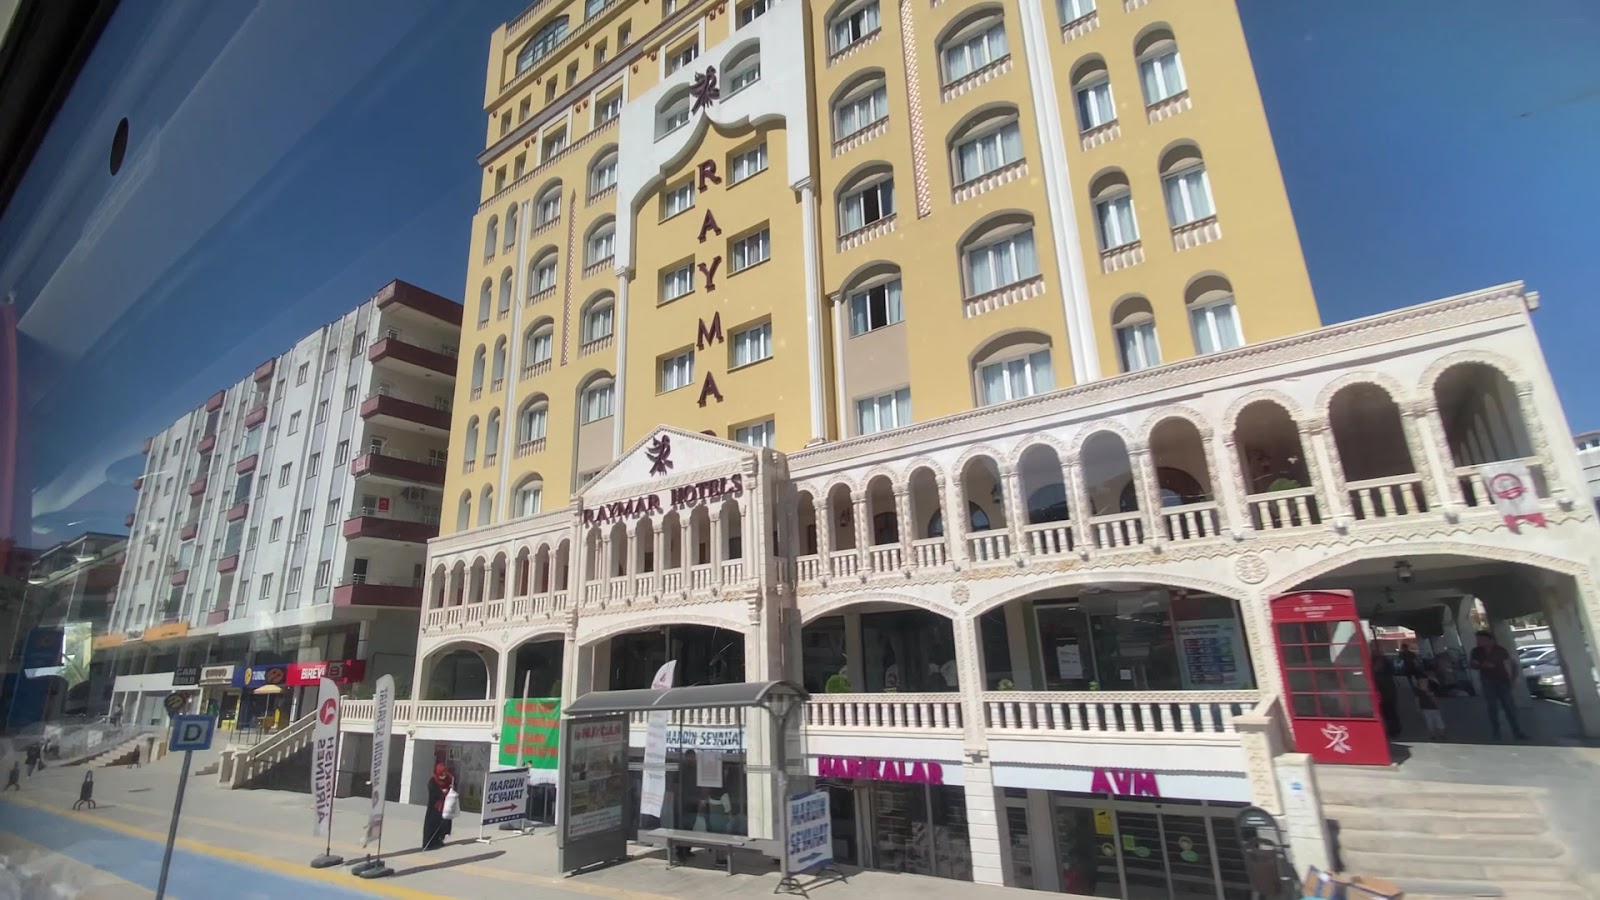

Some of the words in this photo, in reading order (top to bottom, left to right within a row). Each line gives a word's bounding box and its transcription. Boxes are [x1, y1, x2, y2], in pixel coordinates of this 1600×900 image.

[696, 158, 724, 438] RAYMA
[583, 494, 661, 526] RAYMAR
[670, 473, 743, 507] HOTELS
[183, 723, 203, 741] D
[488, 777, 525, 792] MARDİN
[1091, 767, 1160, 798] AVM
[486, 789, 524, 804] SEYAHAT
